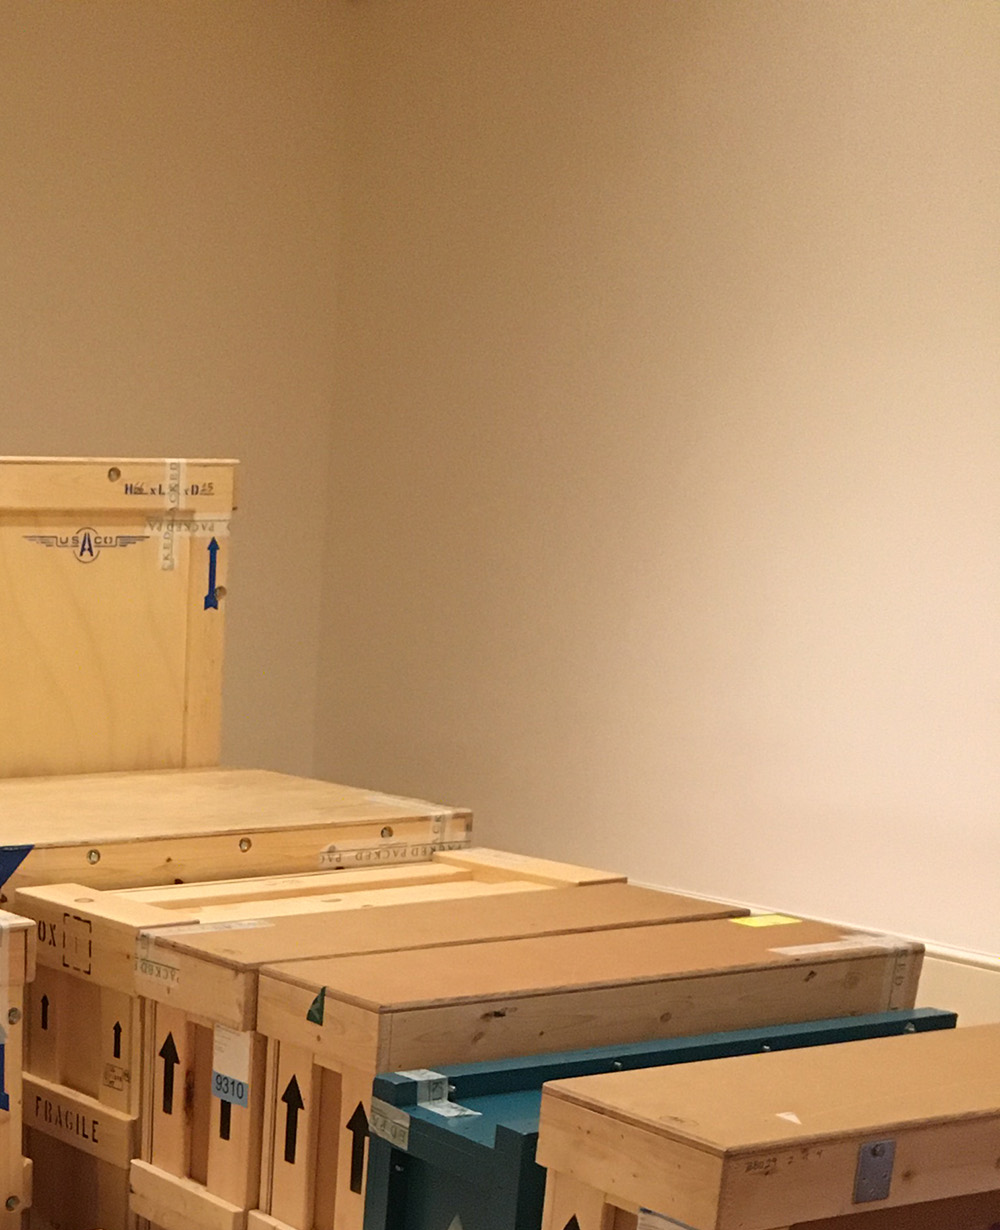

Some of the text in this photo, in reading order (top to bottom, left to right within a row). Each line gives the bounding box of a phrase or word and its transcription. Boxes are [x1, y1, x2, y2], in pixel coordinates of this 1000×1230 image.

[355, 848, 407, 862] PACKED
[215, 1074, 244, 1100] 9310
[35, 1096, 99, 1144] FRAGILE
